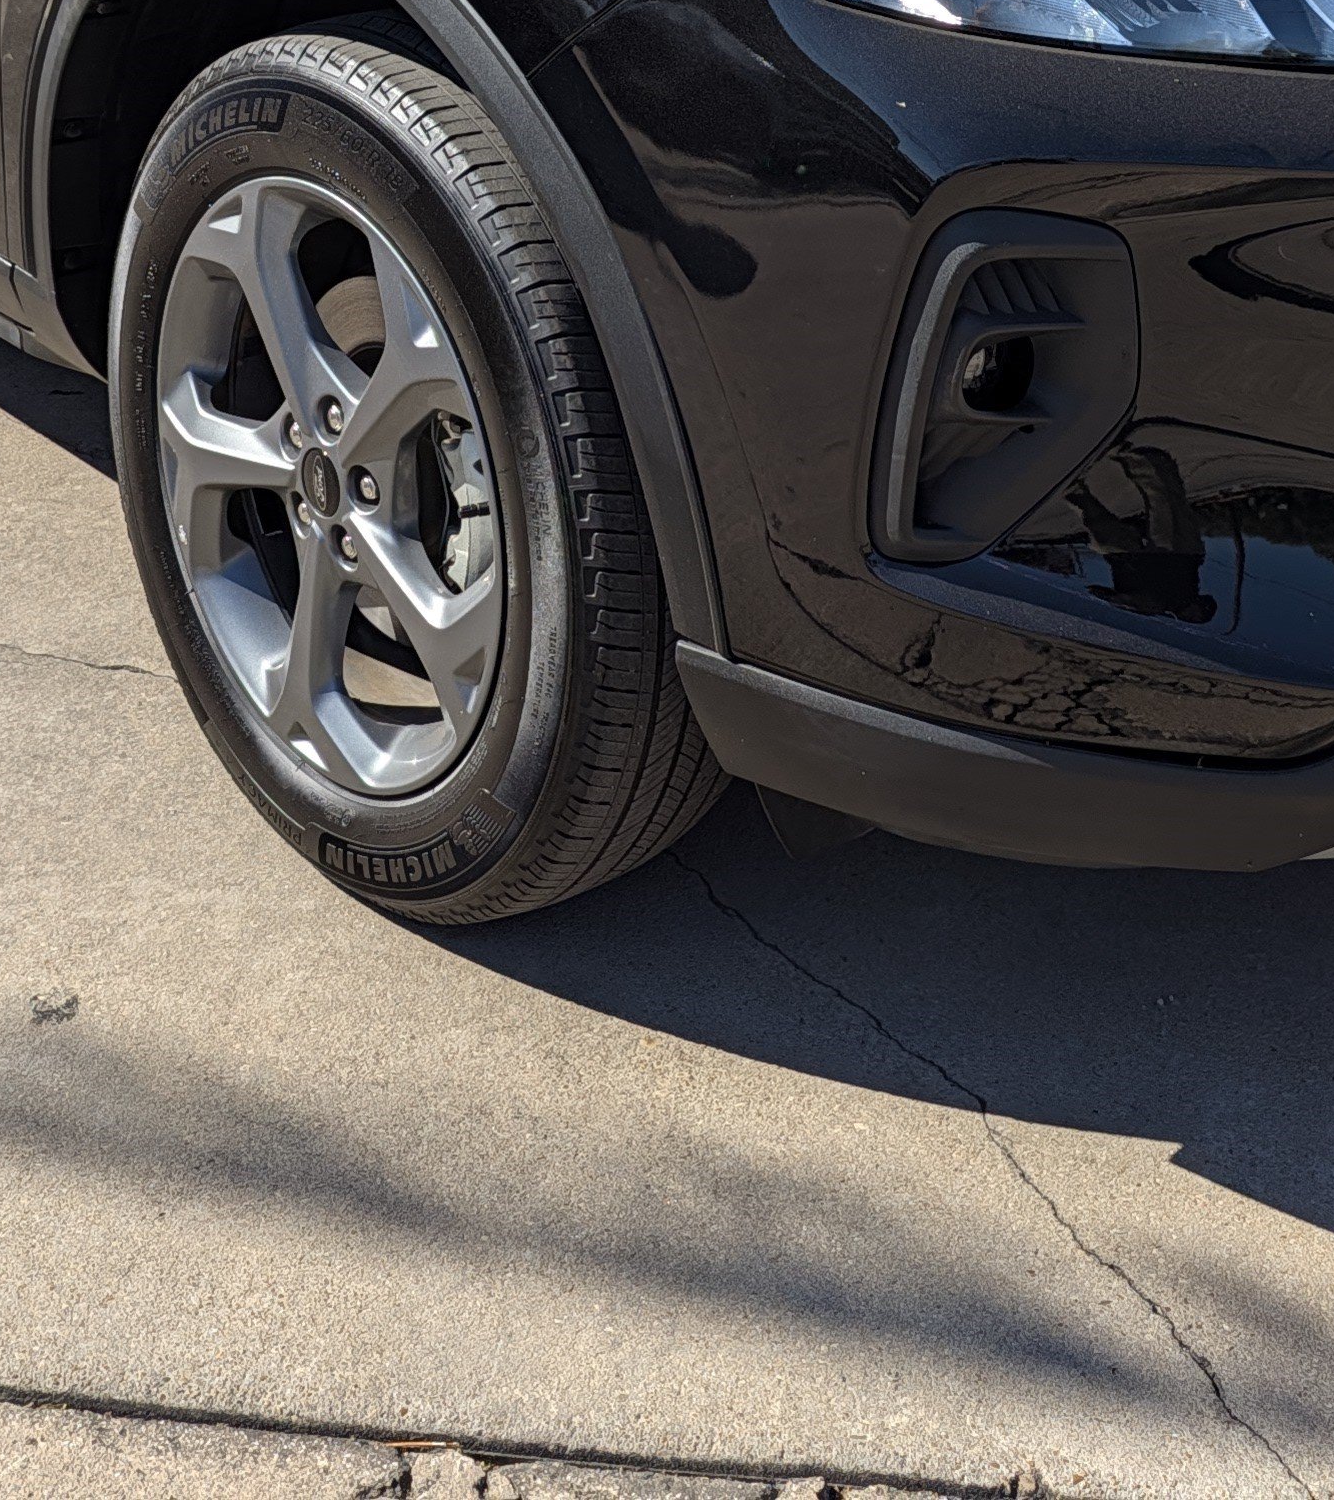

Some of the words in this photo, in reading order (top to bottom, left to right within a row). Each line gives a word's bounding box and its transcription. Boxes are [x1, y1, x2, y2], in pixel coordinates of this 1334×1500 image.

[170, 96, 283, 167] MICHELIN
[239, 774, 304, 847] PRIMACY
[325, 839, 458, 884] MICHELIN
